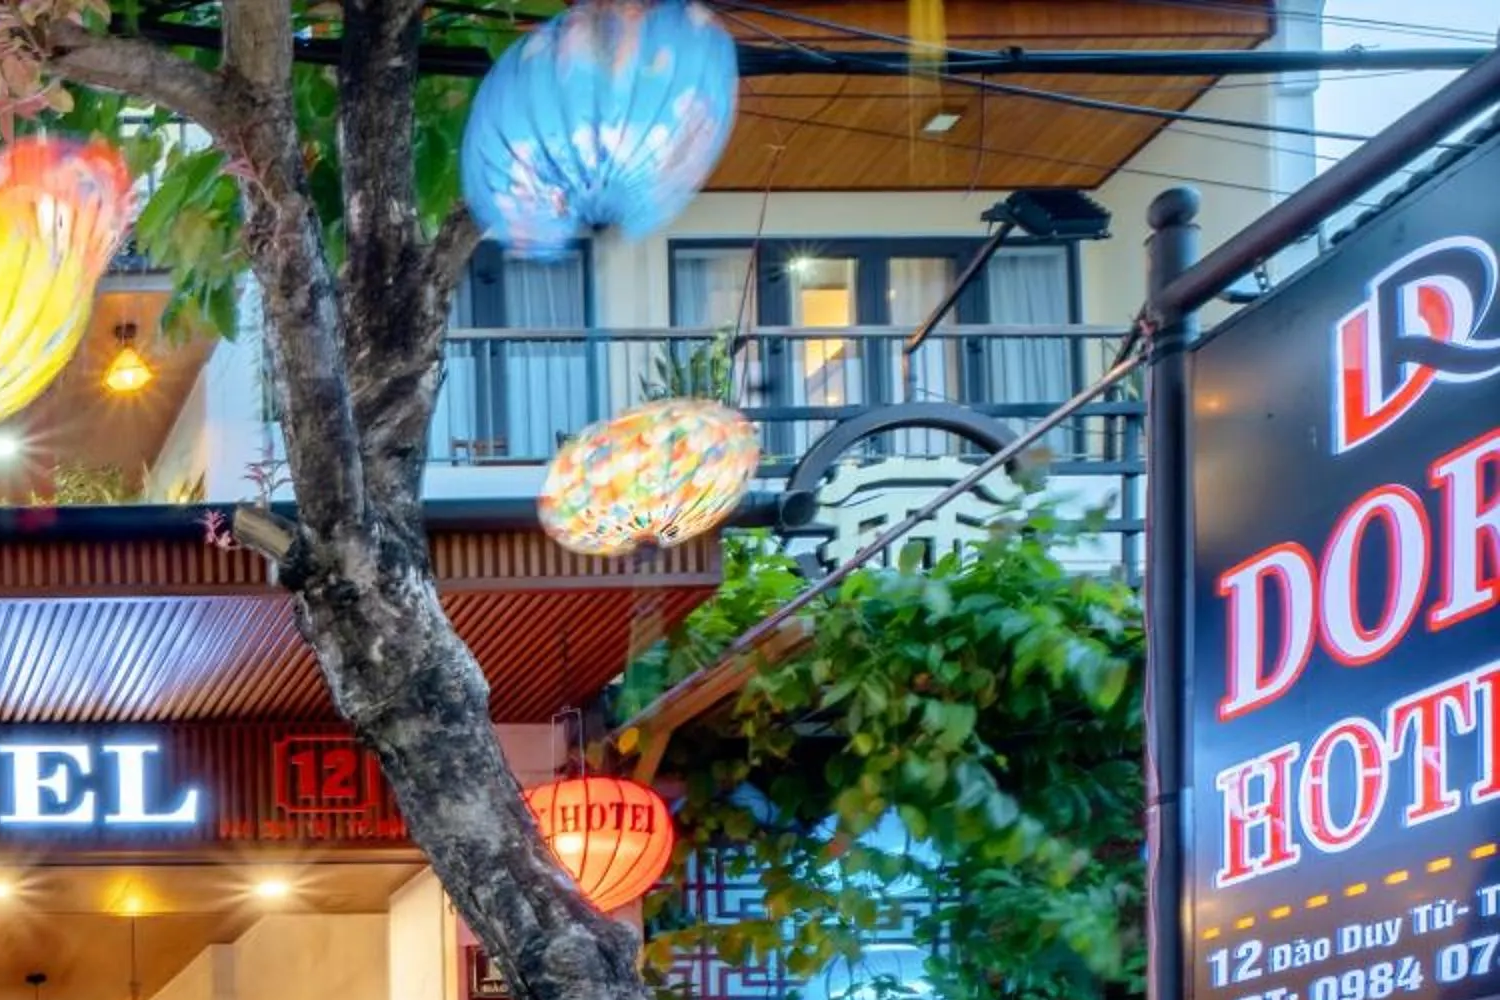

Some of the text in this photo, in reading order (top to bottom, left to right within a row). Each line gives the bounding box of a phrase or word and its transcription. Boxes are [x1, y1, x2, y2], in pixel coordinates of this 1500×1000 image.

[291, 749, 358, 799] 12
[1207, 939, 1263, 988] 12
[1338, 916, 1404, 955] Duy
[1436, 932, 1500, 983] 07
